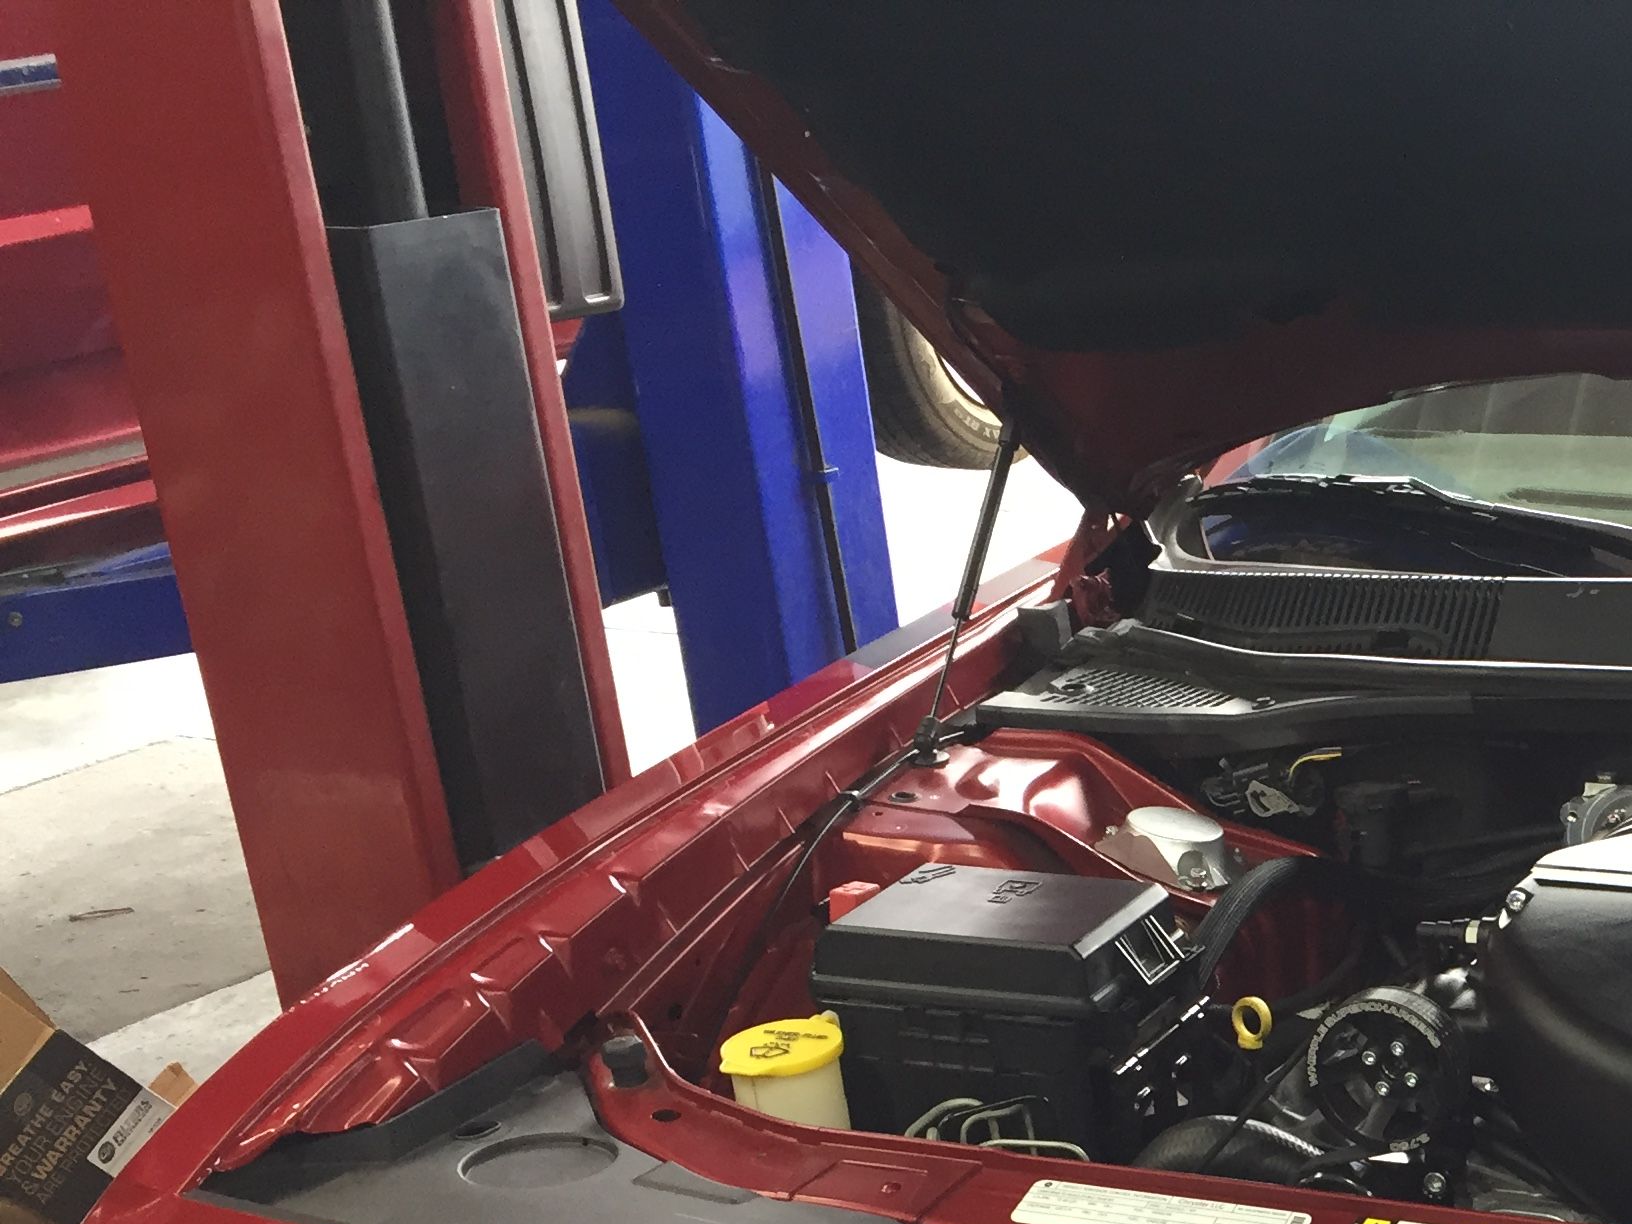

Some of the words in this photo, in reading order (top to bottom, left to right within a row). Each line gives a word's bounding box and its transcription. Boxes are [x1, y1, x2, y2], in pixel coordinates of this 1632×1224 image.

[7, 1135, 50, 1183] YOUR
[46, 1067, 105, 1136] ENGINE
[31, 1078, 117, 1181] WARRANTY
